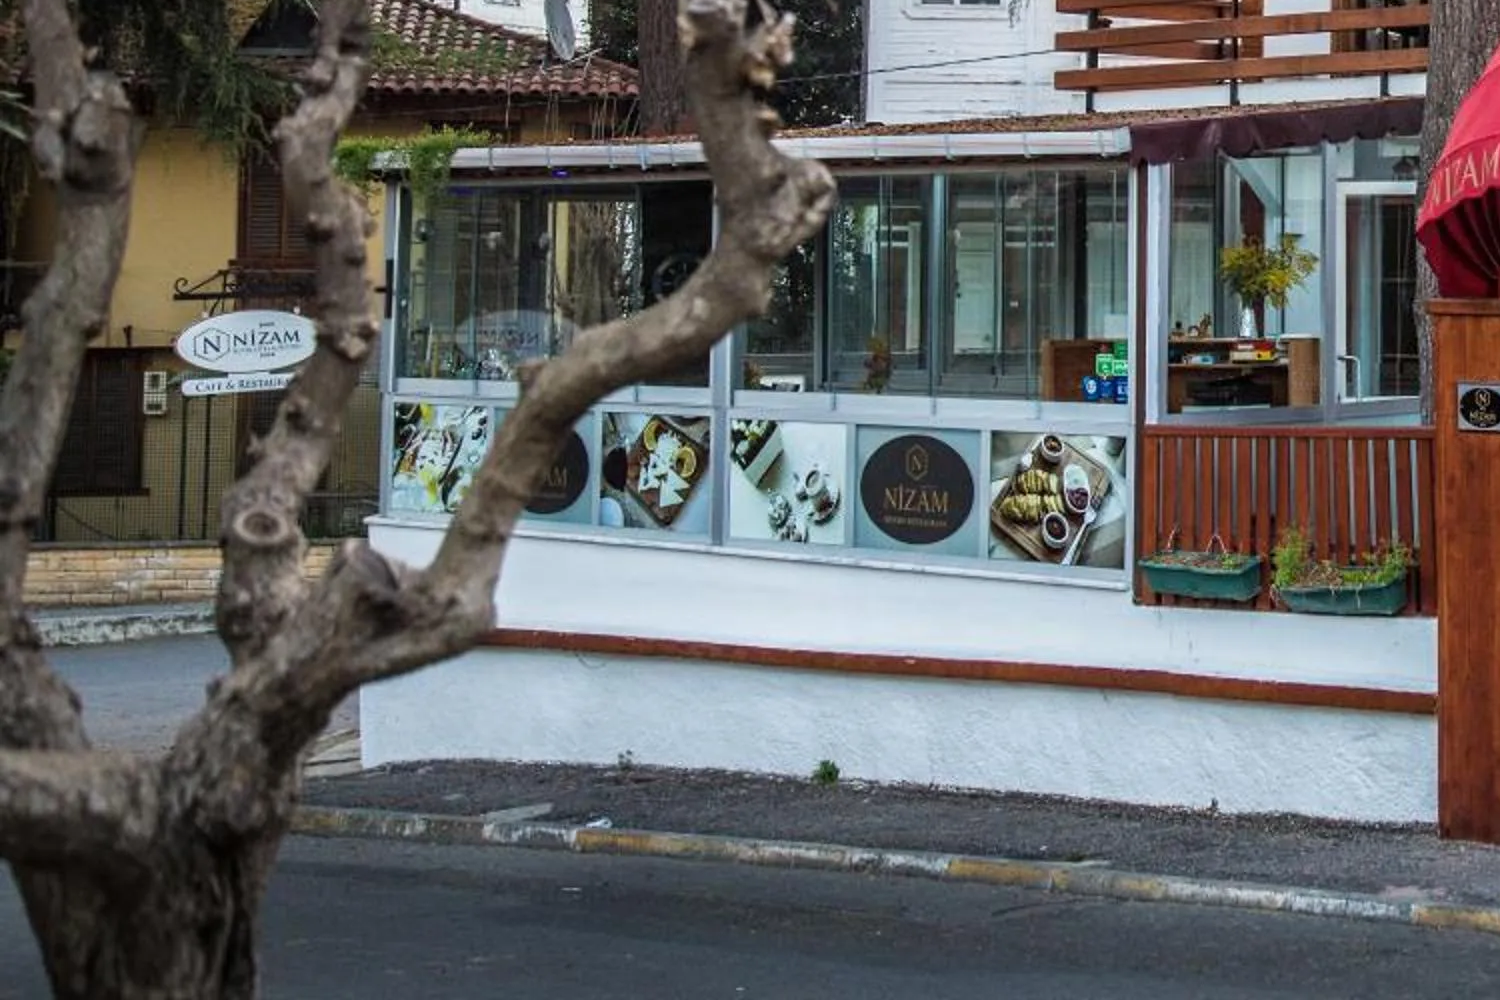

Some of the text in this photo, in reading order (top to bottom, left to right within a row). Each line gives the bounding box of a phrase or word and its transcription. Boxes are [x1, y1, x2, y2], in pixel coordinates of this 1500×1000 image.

[203, 335, 221, 354] N
[233, 329, 301, 347] NİZAM
[884, 483, 949, 513] NİZAM
